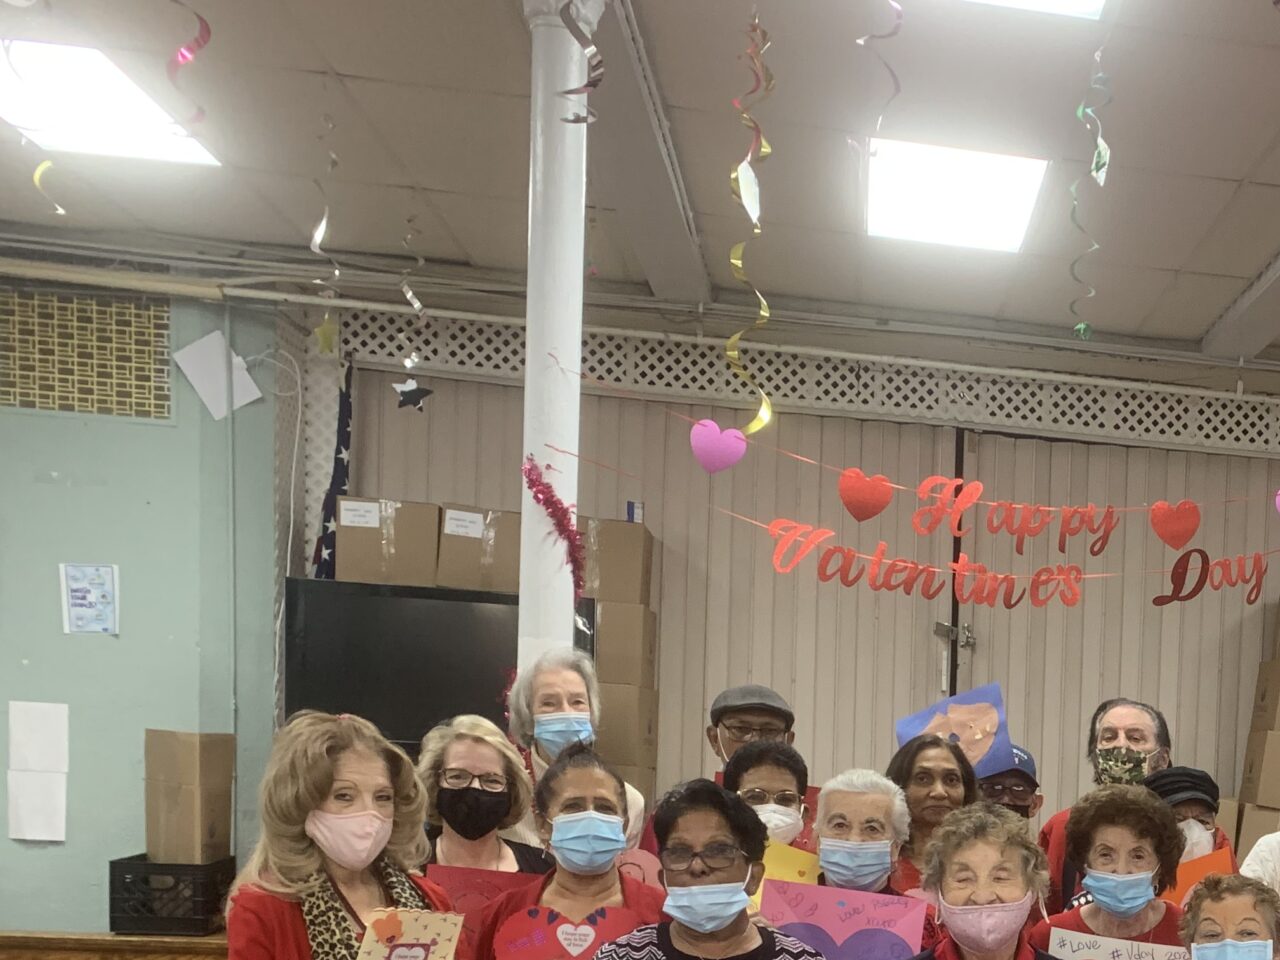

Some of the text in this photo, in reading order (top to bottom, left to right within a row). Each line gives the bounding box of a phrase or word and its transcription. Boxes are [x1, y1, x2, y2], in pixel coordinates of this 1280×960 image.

[912, 475, 1120, 556] Happy
[1152, 549, 1267, 605] Day
[1057, 936, 1101, 953] #Love
